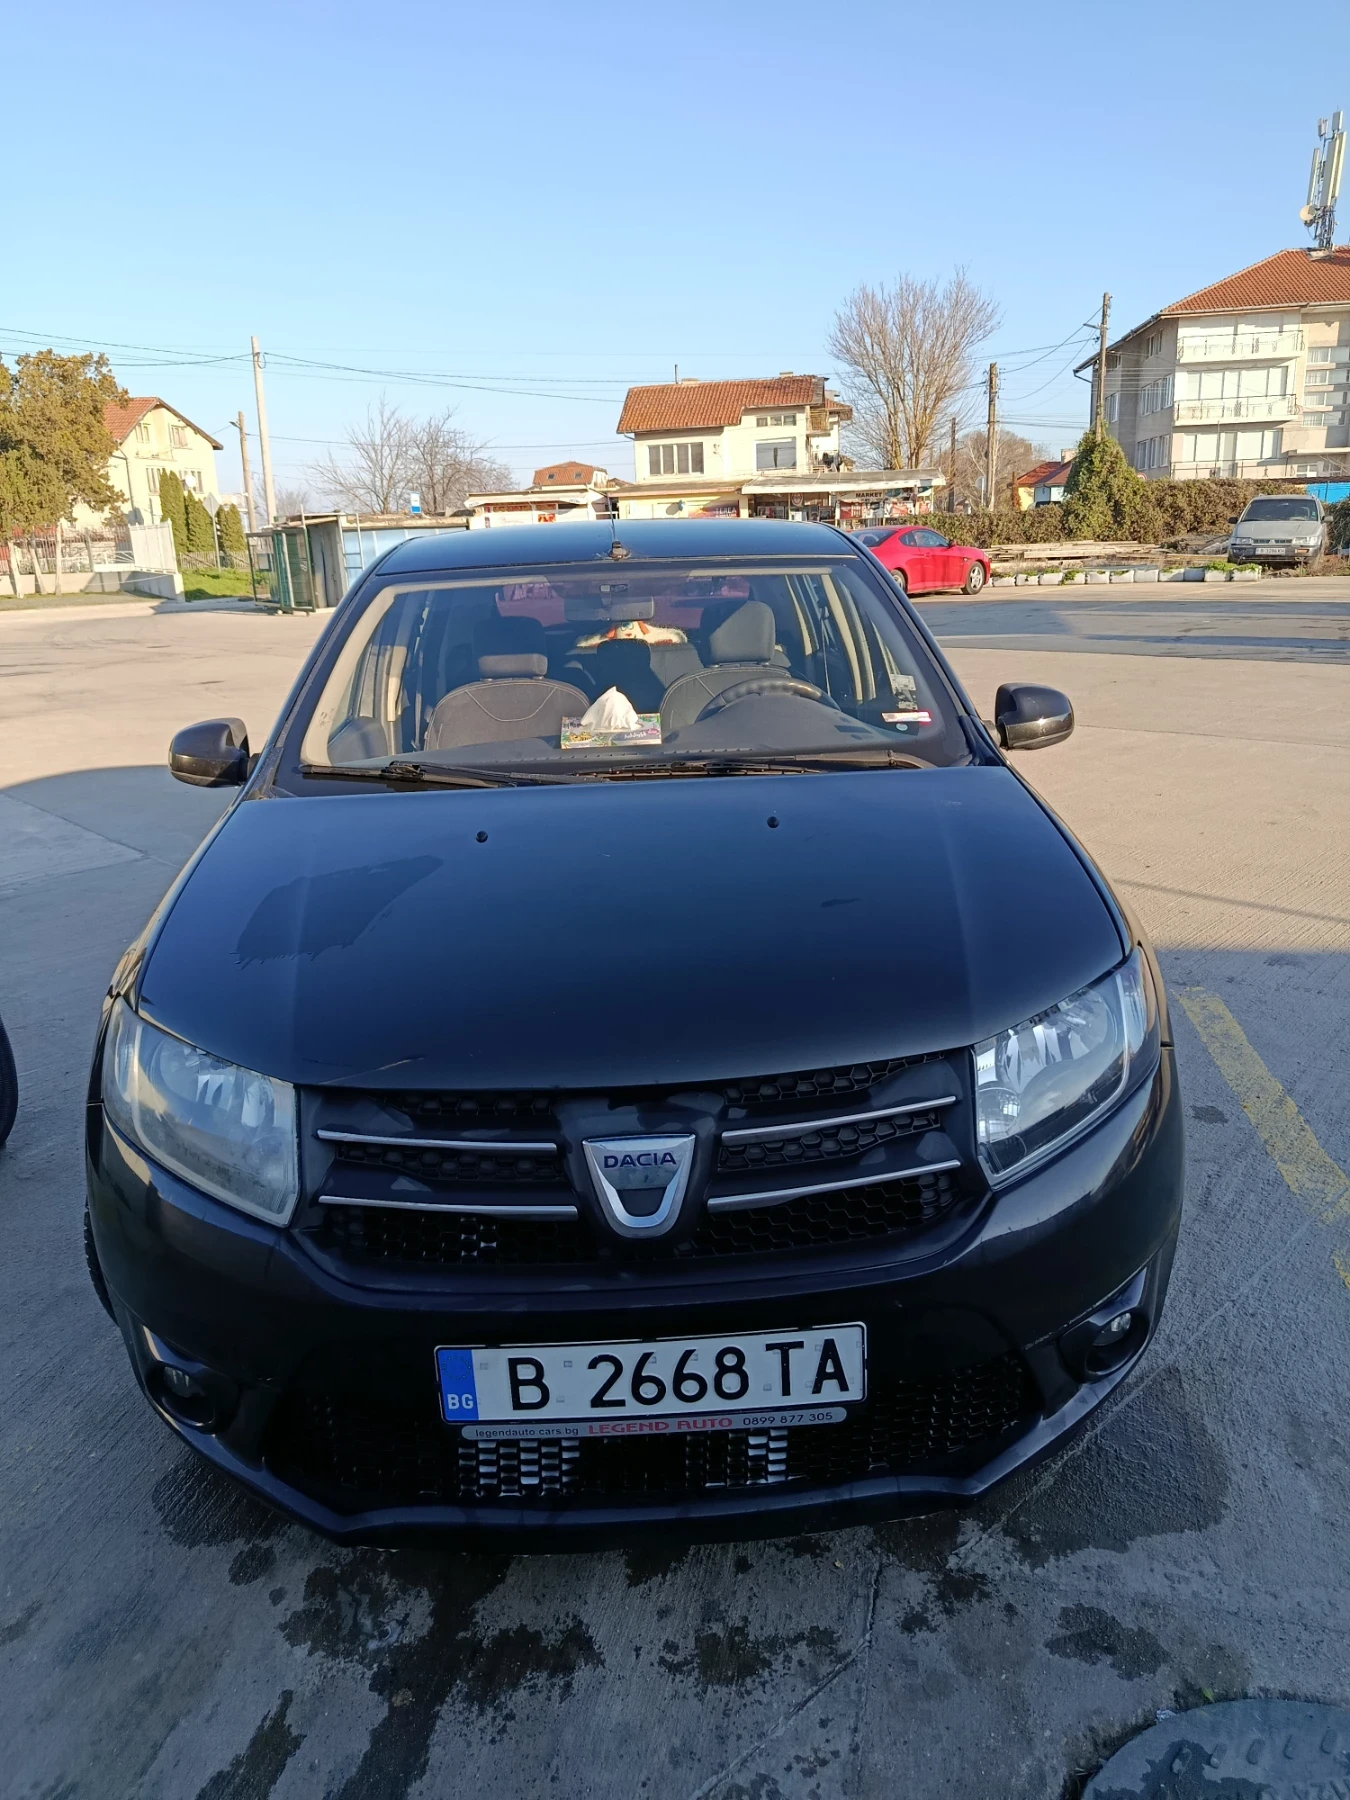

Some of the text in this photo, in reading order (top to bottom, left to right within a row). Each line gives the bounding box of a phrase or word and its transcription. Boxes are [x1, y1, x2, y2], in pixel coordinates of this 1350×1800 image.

[603, 1152, 677, 1169] DACIA
[507, 1338, 850, 1411] B 2668 TA
[447, 1393, 474, 1410] BG
[588, 1420, 669, 1435] LEGEND
[677, 1417, 733, 1430] AUTO
[743, 1415, 775, 1426] 0899
[780, 1413, 804, 1424] 877
[808, 1412, 833, 1422] 305
